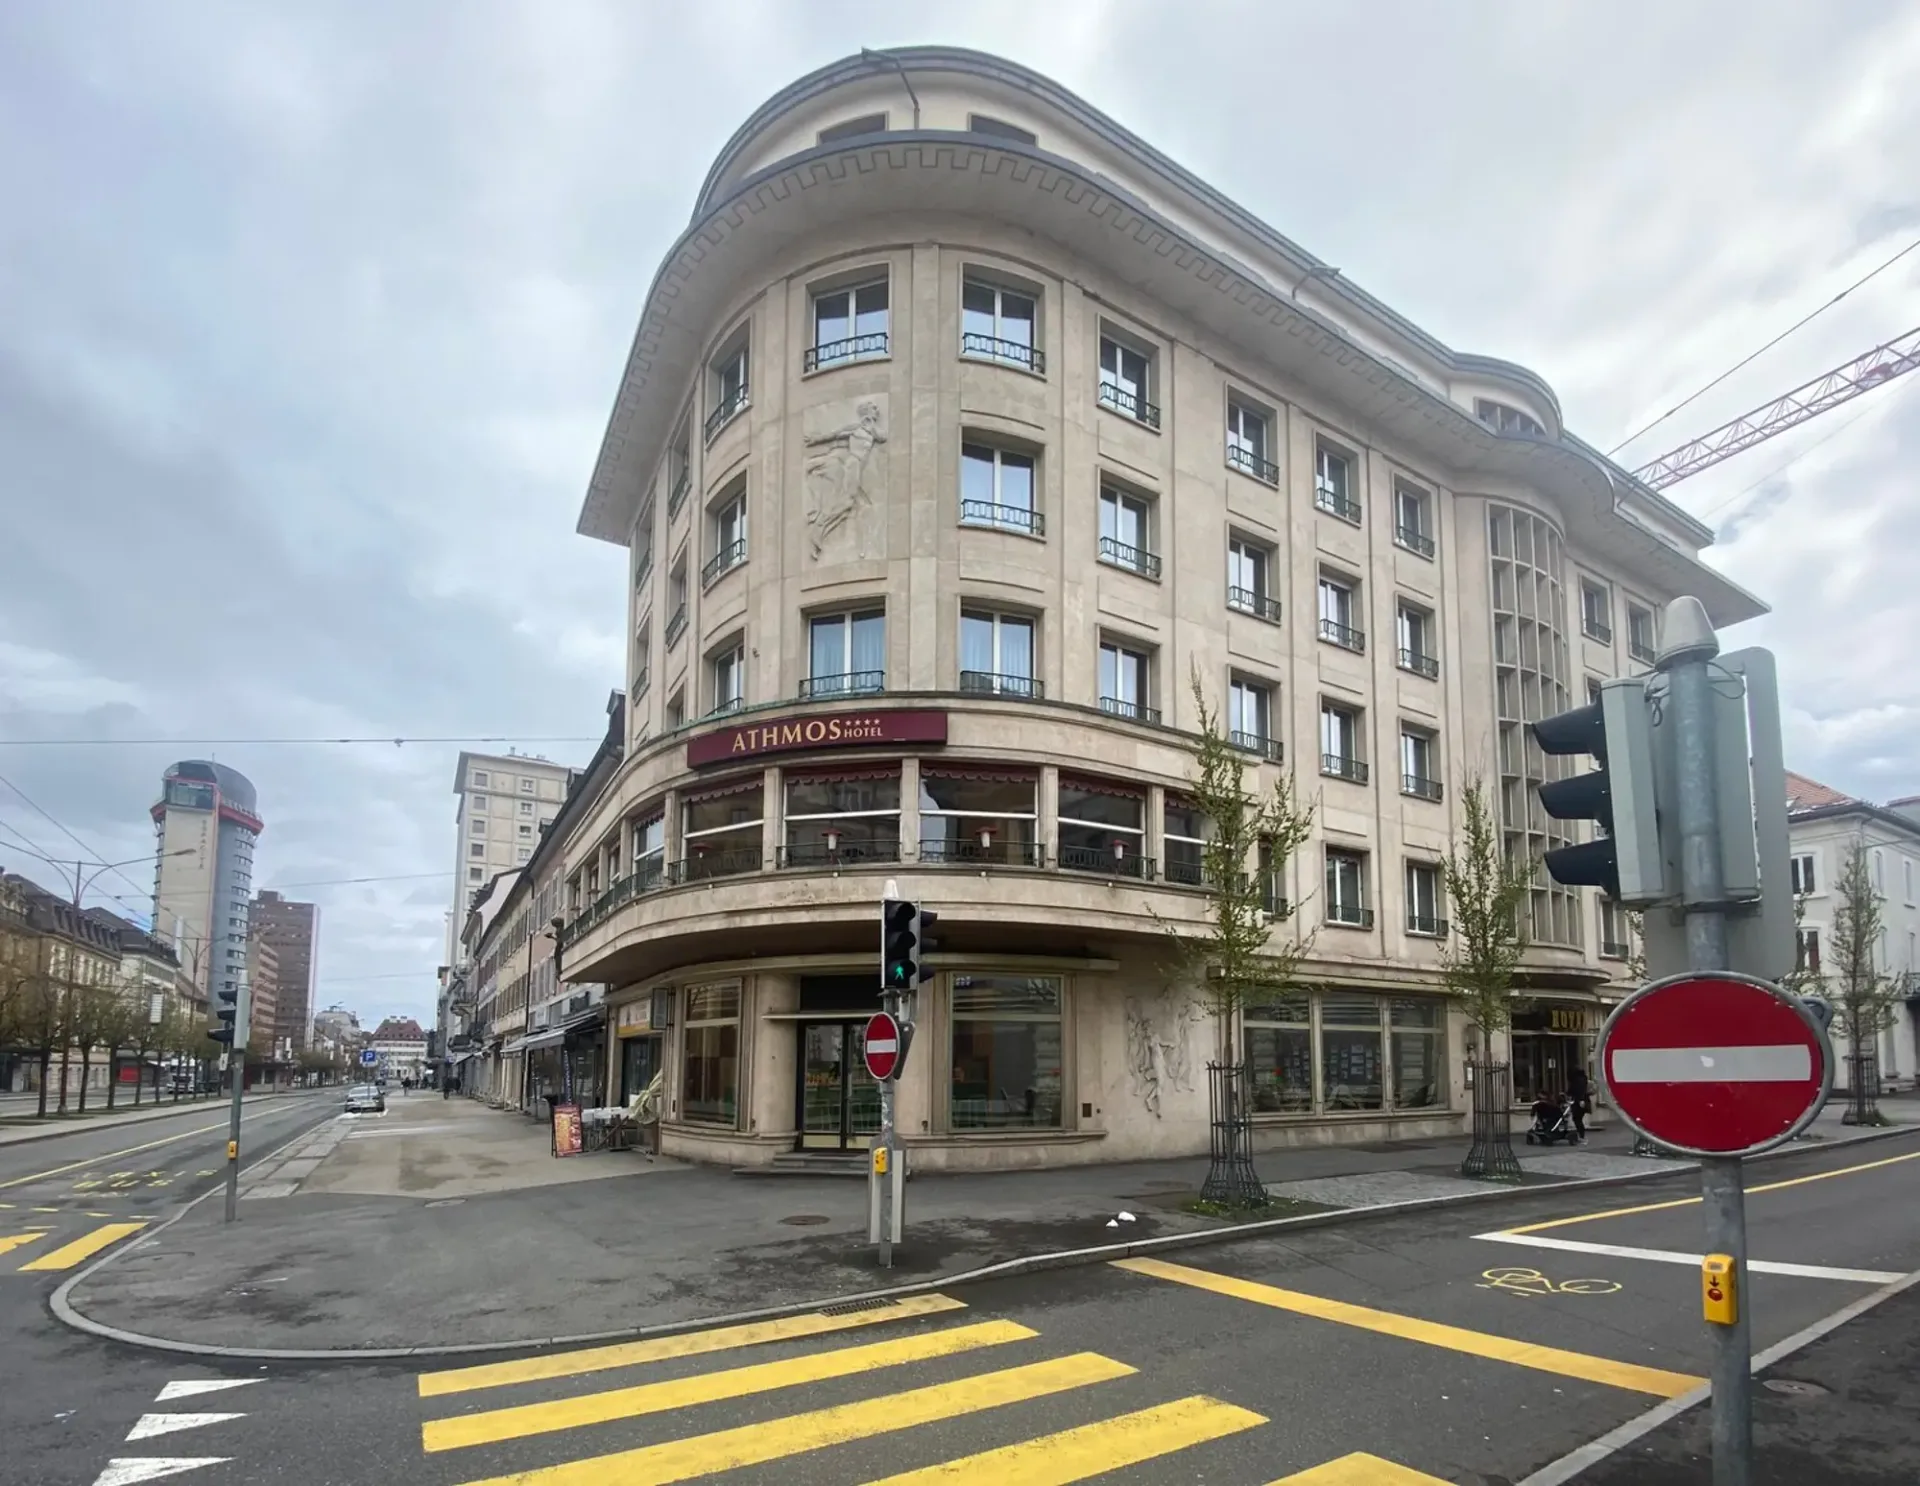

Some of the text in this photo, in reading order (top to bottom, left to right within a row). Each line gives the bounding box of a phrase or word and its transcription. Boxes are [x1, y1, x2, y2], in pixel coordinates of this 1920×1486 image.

[732, 719, 883, 753] ATHMOS HOTEL
[365, 1051, 374, 1062] P
